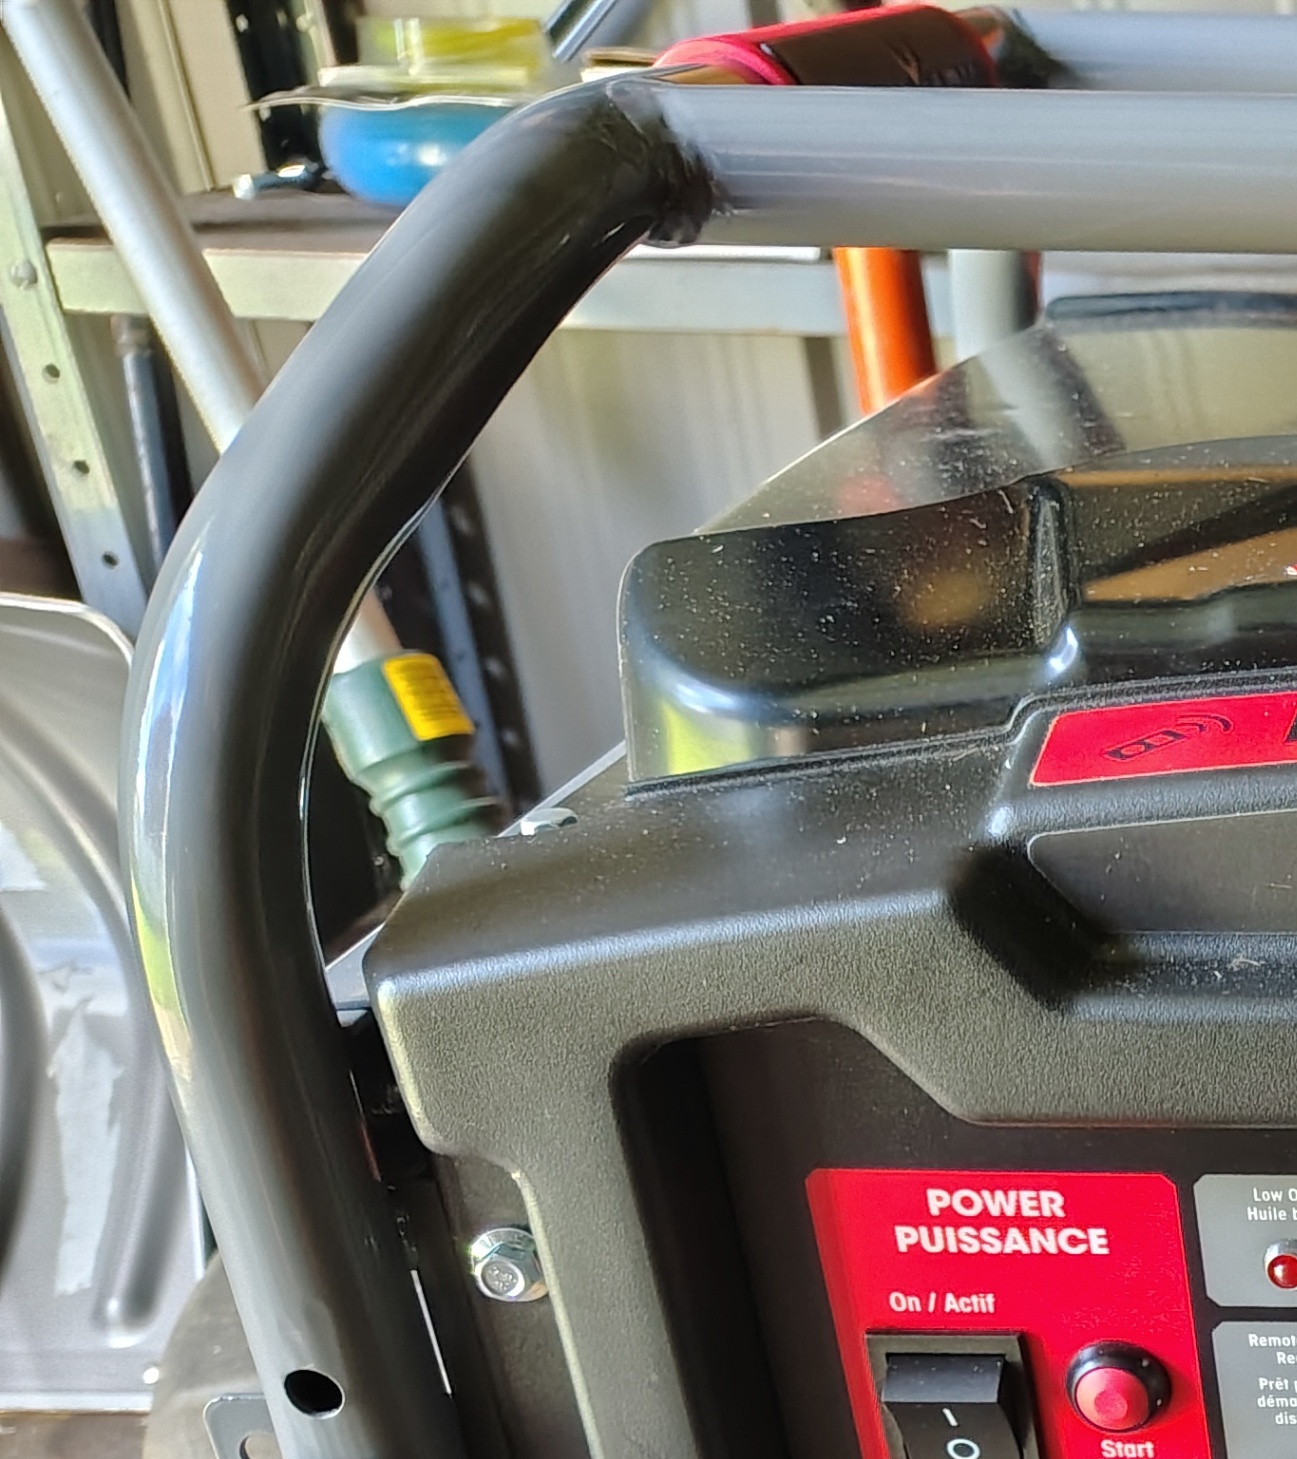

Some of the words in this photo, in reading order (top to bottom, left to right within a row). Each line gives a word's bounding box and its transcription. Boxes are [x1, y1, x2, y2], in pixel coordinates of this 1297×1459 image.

[926, 1188, 1066, 1218] POWER
[1253, 1188, 1284, 1203] Low
[1246, 1206, 1288, 1222] Huile
[894, 1225, 1111, 1256] PUISSANCE
[889, 1291, 921, 1313] On
[944, 1292, 996, 1314] Actif
[1259, 1376, 1291, 1392] Prêt
[1101, 1439, 1155, 1459] Start
